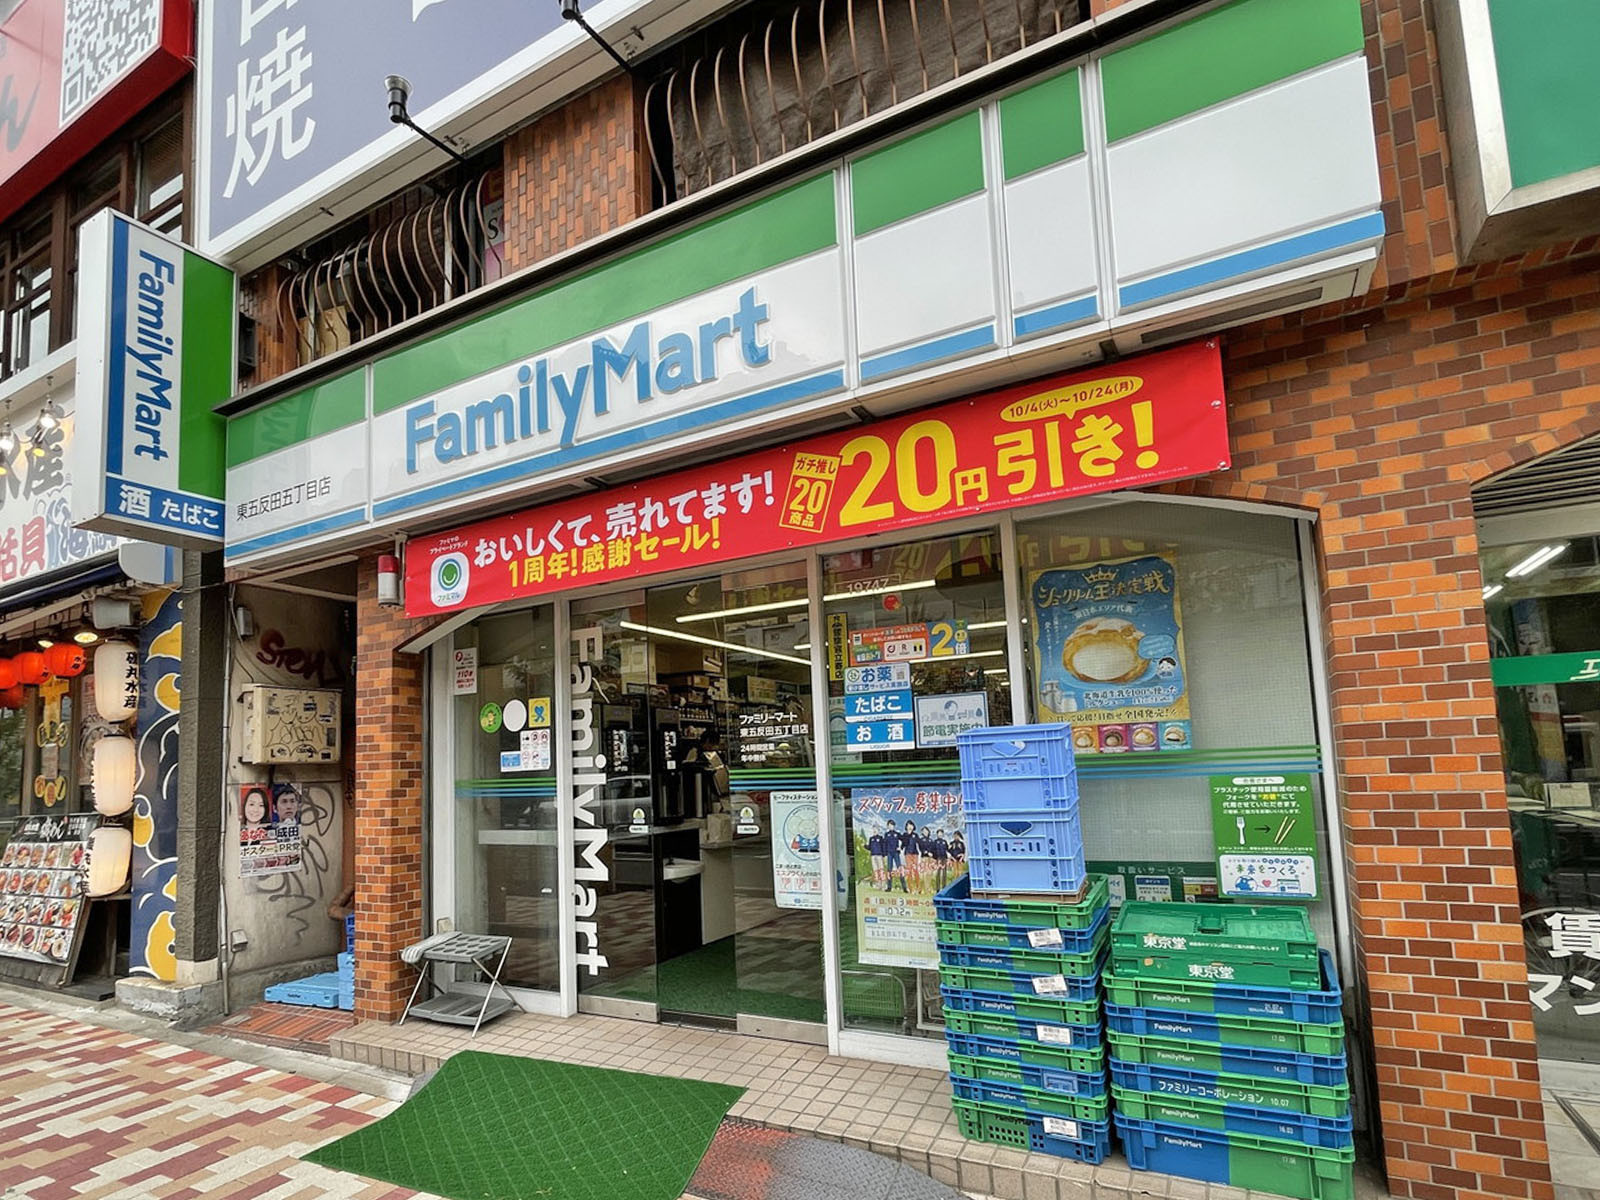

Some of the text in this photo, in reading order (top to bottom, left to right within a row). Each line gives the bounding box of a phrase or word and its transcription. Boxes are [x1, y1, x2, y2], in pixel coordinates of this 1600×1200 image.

[126, 249, 175, 461] FamilyMart
[406, 285, 771, 474] FamilyMart
[795, 454, 838, 476] ガチ推し
[236, 476, 332, 522] 東五反田五丁目店
[788, 476, 826, 514] 20
[118, 483, 220, 530] 酒 たばこ
[473, 469, 775, 569] おいしくて、売れてます!
[790, 511, 816, 529] 商品
[508, 518, 722, 589] 1周年!感謝セール!
[861, 665, 893, 683] お薬
[855, 695, 902, 714] たばこ
[739, 711, 798, 725] ファミリーマート
[740, 724, 809, 737] 東五反田五丁目店
[856, 722, 904, 742] お酒
[571, 625, 610, 976] FamilyMart
[973, 911, 1008, 920] FamilyMart
[1143, 934, 1188, 951] 東京堂
[1543, 911, 1600, 960] 賃
[1188, 964, 1235, 980] 東京堂
[980, 1002, 1015, 1010] FamilyMart
[1152, 994, 1191, 1004] FamilyMart
[1154, 1023, 1193, 1033] FamilyMart
[986, 1046, 1020, 1057] FamilyMart
[1157, 1051, 1196, 1063] FamilyMart
[988, 1070, 1022, 1079] FamilyMart
[990, 1091, 1017, 1100] FamilyMart
[1158, 1080, 1264, 1104] ファミリーコーポレーション
[1161, 1108, 1200, 1120] FamilyMart
[1163, 1136, 1203, 1149] FamilyMart
